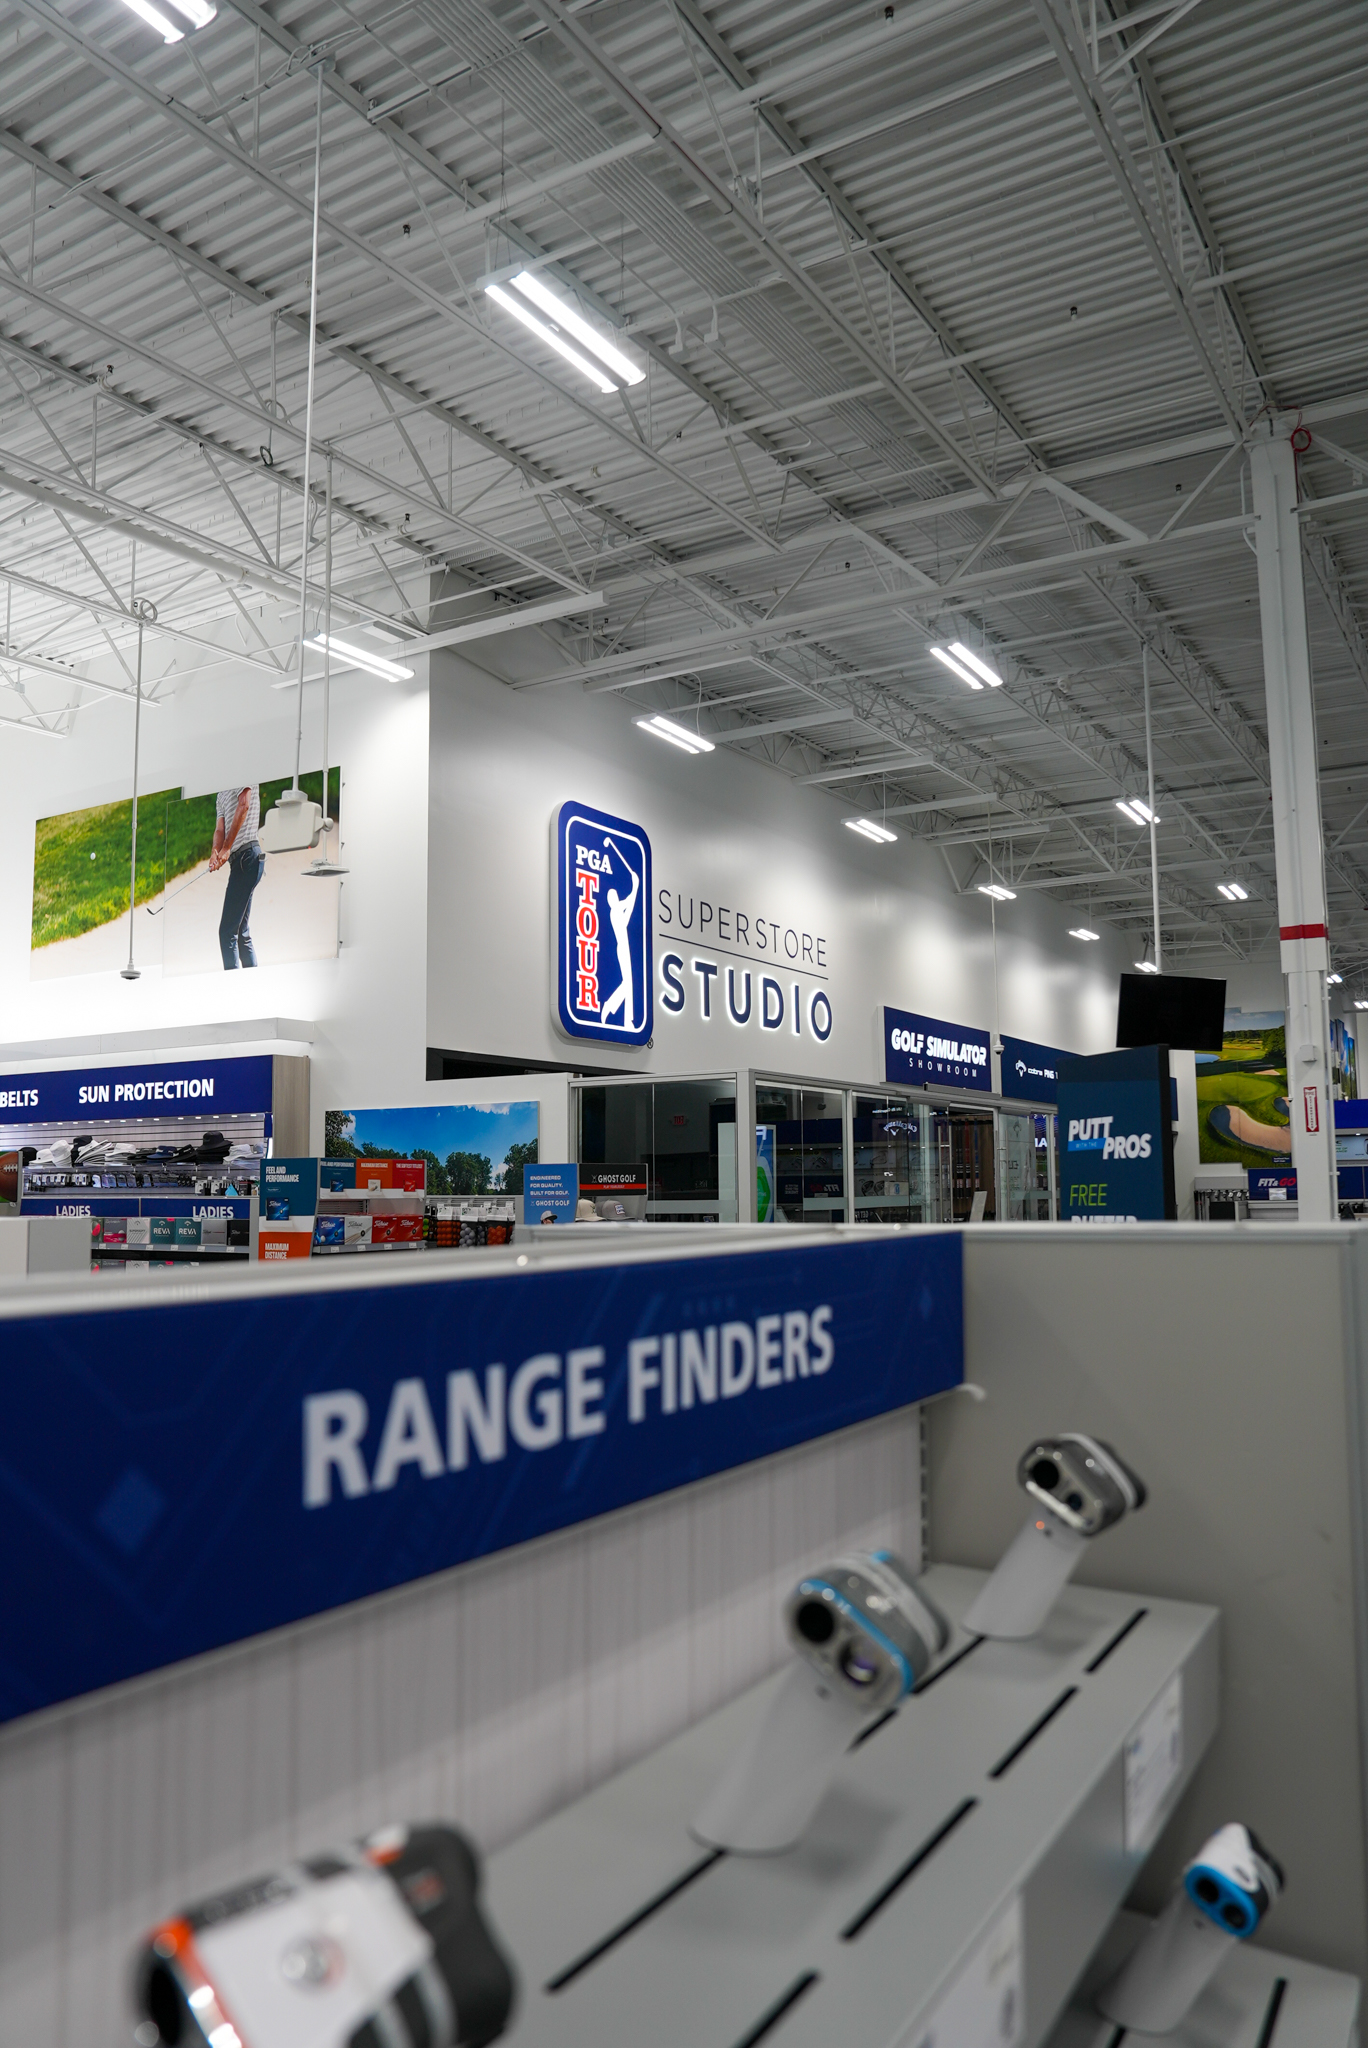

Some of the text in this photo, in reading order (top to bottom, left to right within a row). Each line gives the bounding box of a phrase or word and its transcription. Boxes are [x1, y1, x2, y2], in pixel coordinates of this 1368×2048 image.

[576, 845, 612, 874] PGA
[658, 889, 827, 967] SUPERSTORE
[576, 868, 600, 1012] TOUR
[661, 953, 832, 1042] STUDIO
[891, 1028, 987, 1066] GOLF SIMULATOR
[909, 1057, 977, 1077] SHOWROOM
[0, 1089, 39, 1107] BELTS
[79, 1078, 214, 1104] SUN PROTECTION
[1068, 1116, 1113, 1142] PUTT
[1103, 1133, 1152, 1160] PROS
[266, 1166, 286, 1174] FEEL AND
[266, 1174, 299, 1182] PERFORMANCE
[598, 1174, 636, 1183] GHOST GOLF
[1069, 1184, 1107, 1206] FREE
[56, 1205, 91, 1217] LADIES
[193, 1206, 234, 1218] LADIES
[153, 1227, 171, 1235] REVA
[265, 1243, 289, 1251] MAXIMUM
[302, 1304, 834, 1509] RANGE FINDERS
